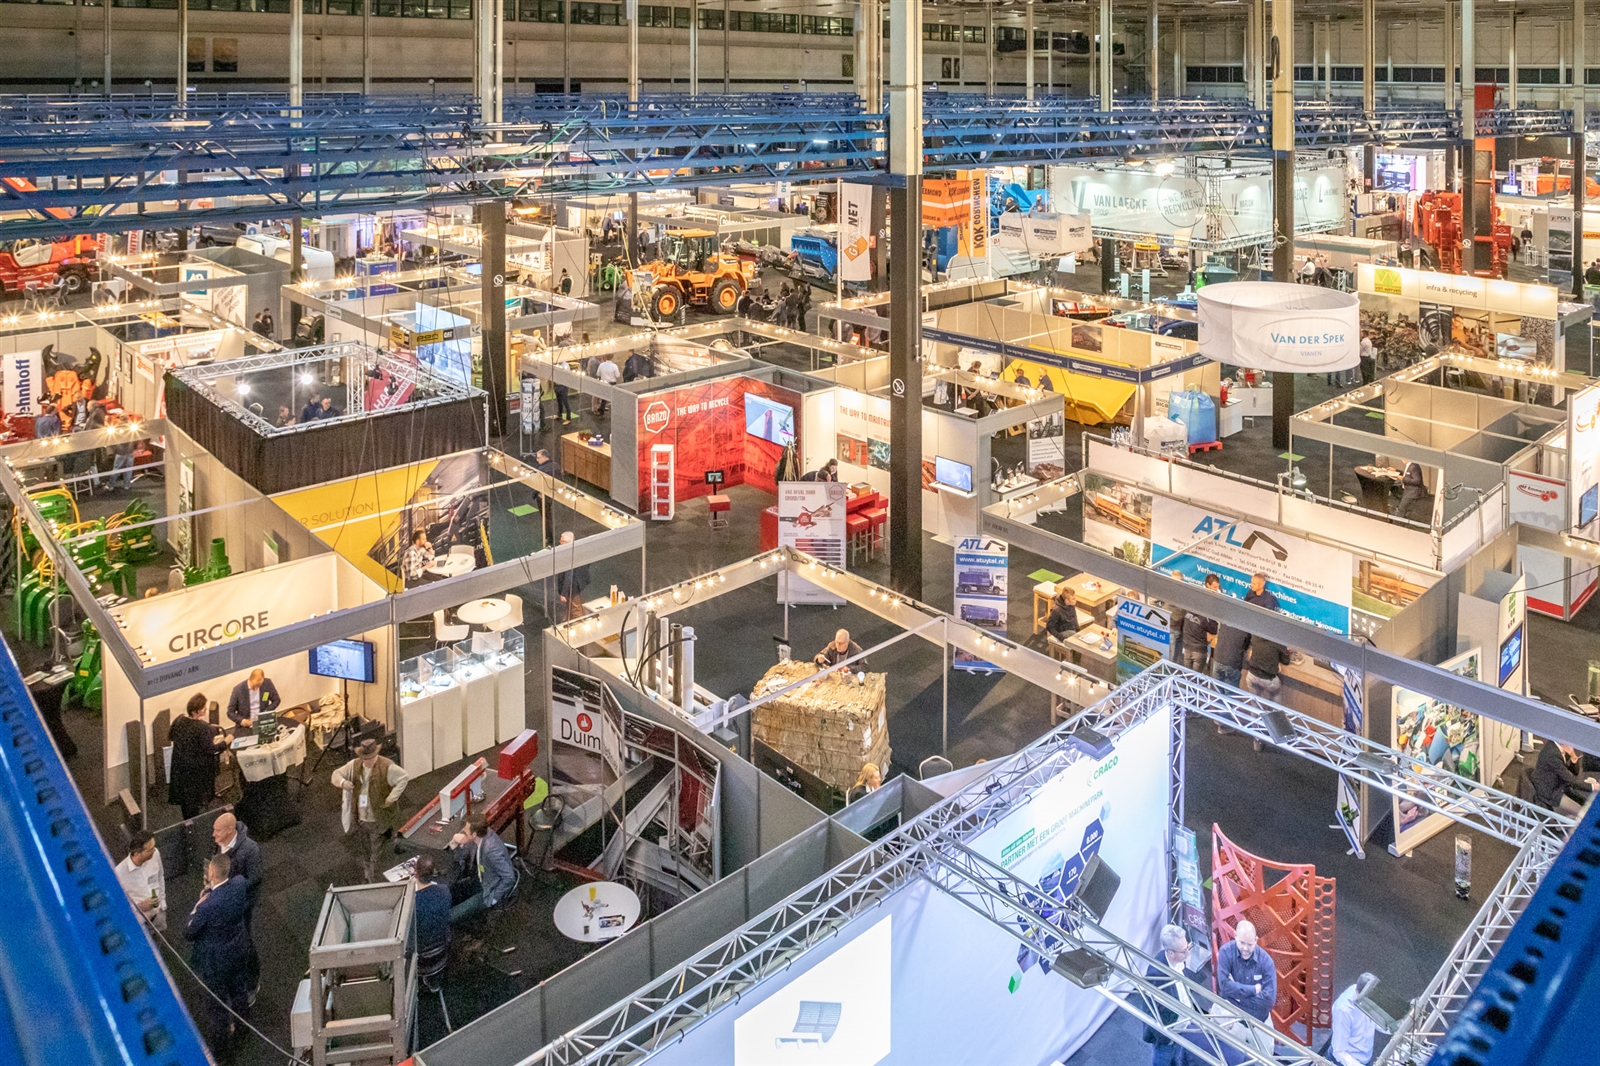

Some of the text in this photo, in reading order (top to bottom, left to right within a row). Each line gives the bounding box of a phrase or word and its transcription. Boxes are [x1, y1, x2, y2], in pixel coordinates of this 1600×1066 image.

[1093, 194, 1111, 207] VAN
[1180, 190, 1194, 200] ARE
[1163, 197, 1205, 216] RECYCLING
[1426, 284, 1441, 292] infra
[1449, 286, 1478, 298] recycling
[1270, 332, 1345, 345] VAN DER SPEK
[15, 359, 31, 415] ehnhoff
[388, 380, 411, 408] WEARPART
[677, 407, 686, 416] THE
[688, 404, 699, 414] WAY
[701, 402, 708, 410] TO
[840, 405, 848, 416] THE
[849, 408, 860, 420] WAY
[861, 411, 868, 422] TO
[311, 501, 374, 526] SOLUTION
[1192, 515, 1243, 548] ATL
[958, 538, 984, 551] ATL
[959, 556, 1005, 565] www.atuytel.nl
[1222, 574, 1235, 583] van
[1119, 600, 1146, 619] ATL
[168, 610, 269, 653] CIRCORE
[1119, 619, 1167, 641] www.atuytel.nl
[561, 717, 601, 751] Duim
[1093, 755, 1119, 781] CRACO
[1001, 846, 1026, 868] PARTNER
[1027, 836, 1039, 849] MET
[1039, 828, 1050, 841] EEN
[1050, 815, 1067, 836] GROOT
[1068, 789, 1104, 820] MACHINEPARK
